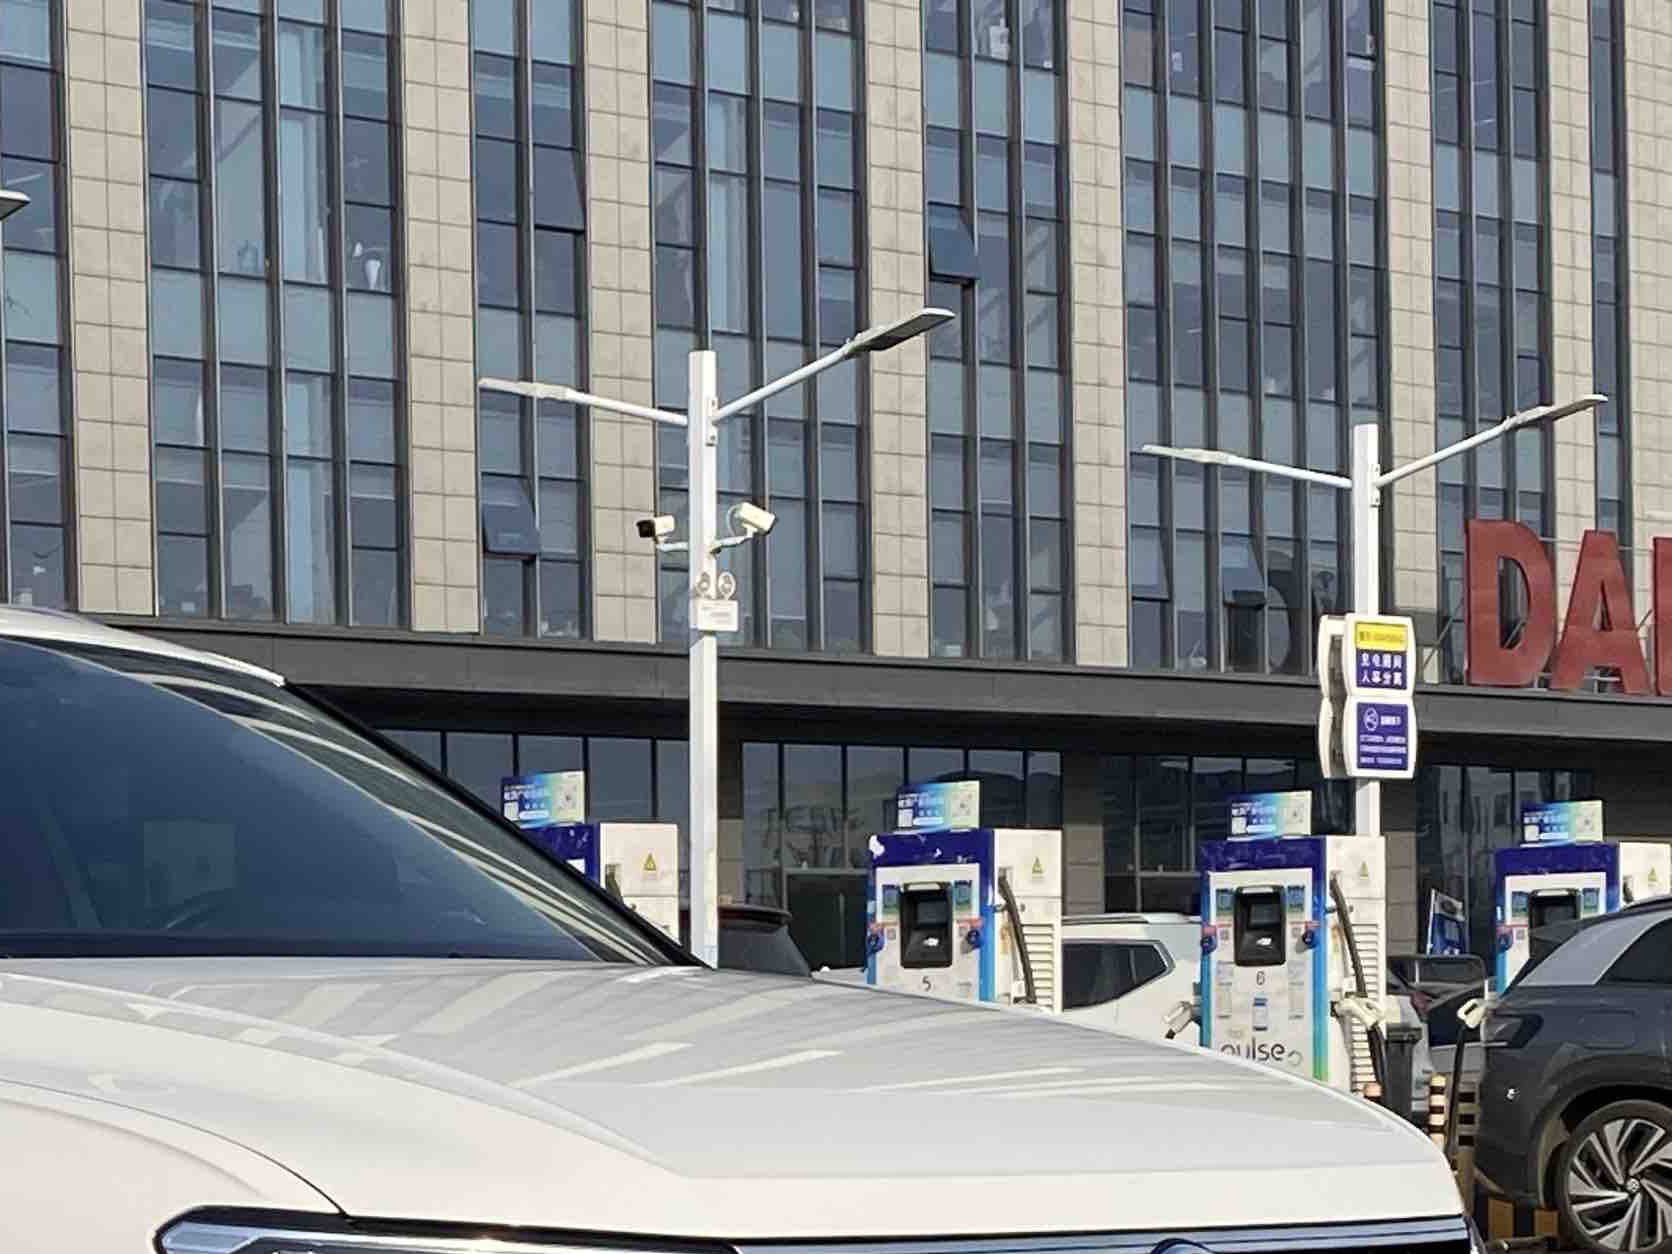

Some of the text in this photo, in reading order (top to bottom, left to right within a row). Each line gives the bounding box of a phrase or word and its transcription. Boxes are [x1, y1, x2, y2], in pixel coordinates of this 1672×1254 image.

[1465, 518, 1672, 696] DA
[922, 975, 932, 991] 5
[1256, 970, 1266, 986] 6
